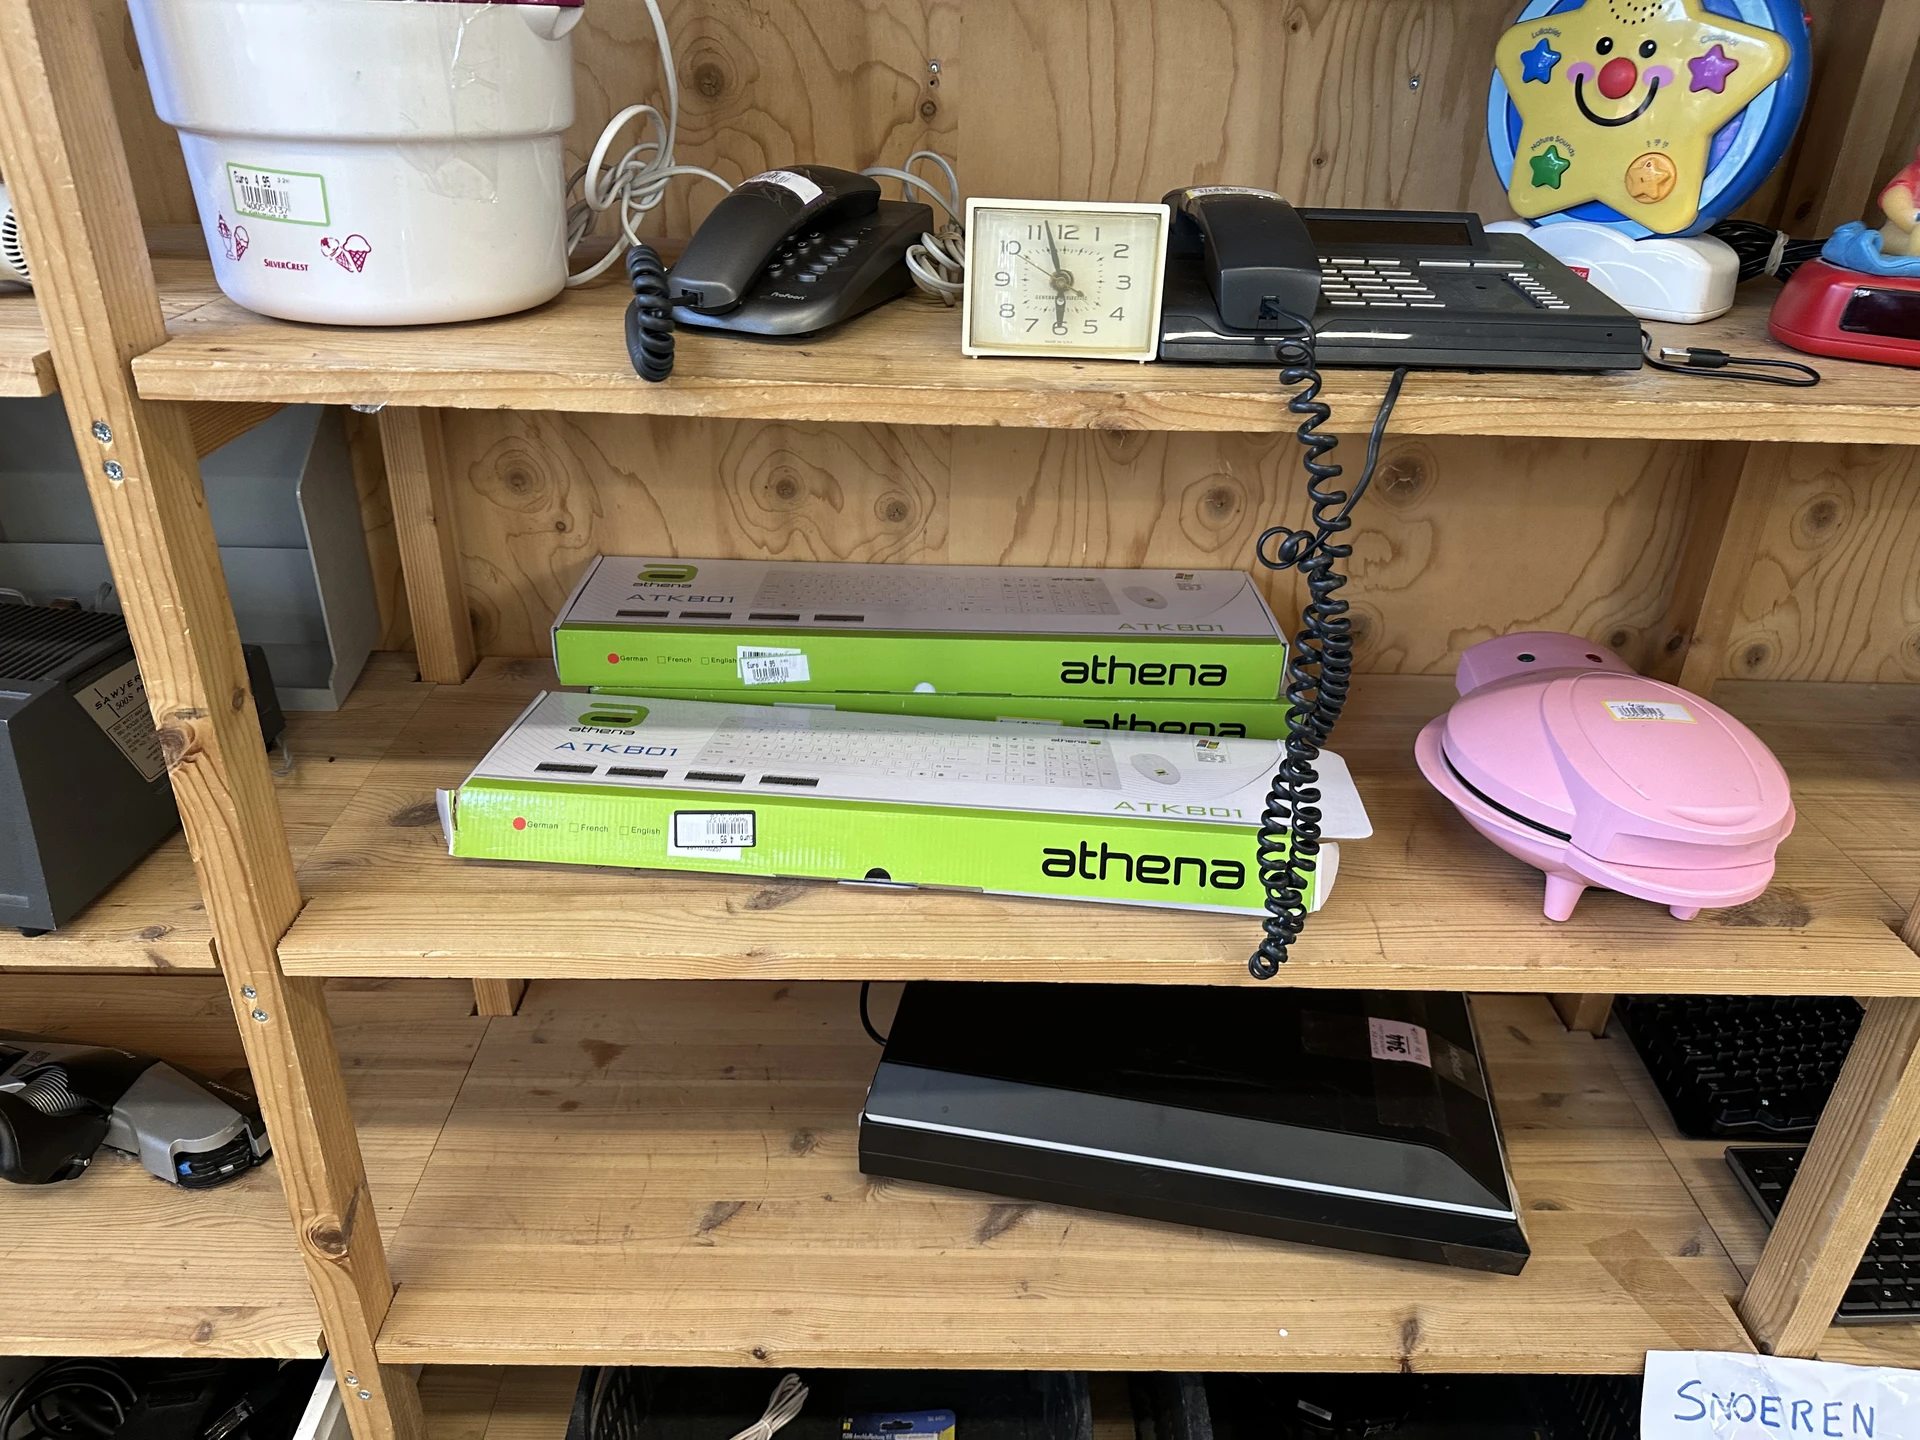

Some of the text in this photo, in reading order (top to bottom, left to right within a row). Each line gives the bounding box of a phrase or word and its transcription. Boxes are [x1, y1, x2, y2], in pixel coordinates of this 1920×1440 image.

[1530, 135, 1575, 157] Nature Sounds
[1028, 225, 1042, 240] 11
[1058, 225, 1079, 240] 12
[1095, 227, 1100, 241] 1
[1000, 240, 1021, 255] 10
[1113, 244, 1129, 258] 2
[994, 272, 1010, 286] 9
[1116, 275, 1131, 290] 3
[999, 303, 1015, 318] 8
[1109, 307, 1125, 321] 4
[1025, 318, 1039, 332] 7
[1052, 321, 1068, 335] 6
[1083, 320, 1098, 334] 5
[1060, 655, 1228, 686] athena
[568, 726, 635, 735] athena
[526, 820, 559, 830] German
[581, 823, 609, 833] French
[631, 826, 661, 835] English
[1042, 840, 1245, 890] athena
[1386, 1034, 1406, 1054] 344
[1674, 1380, 1875, 1438] SNOEREN
